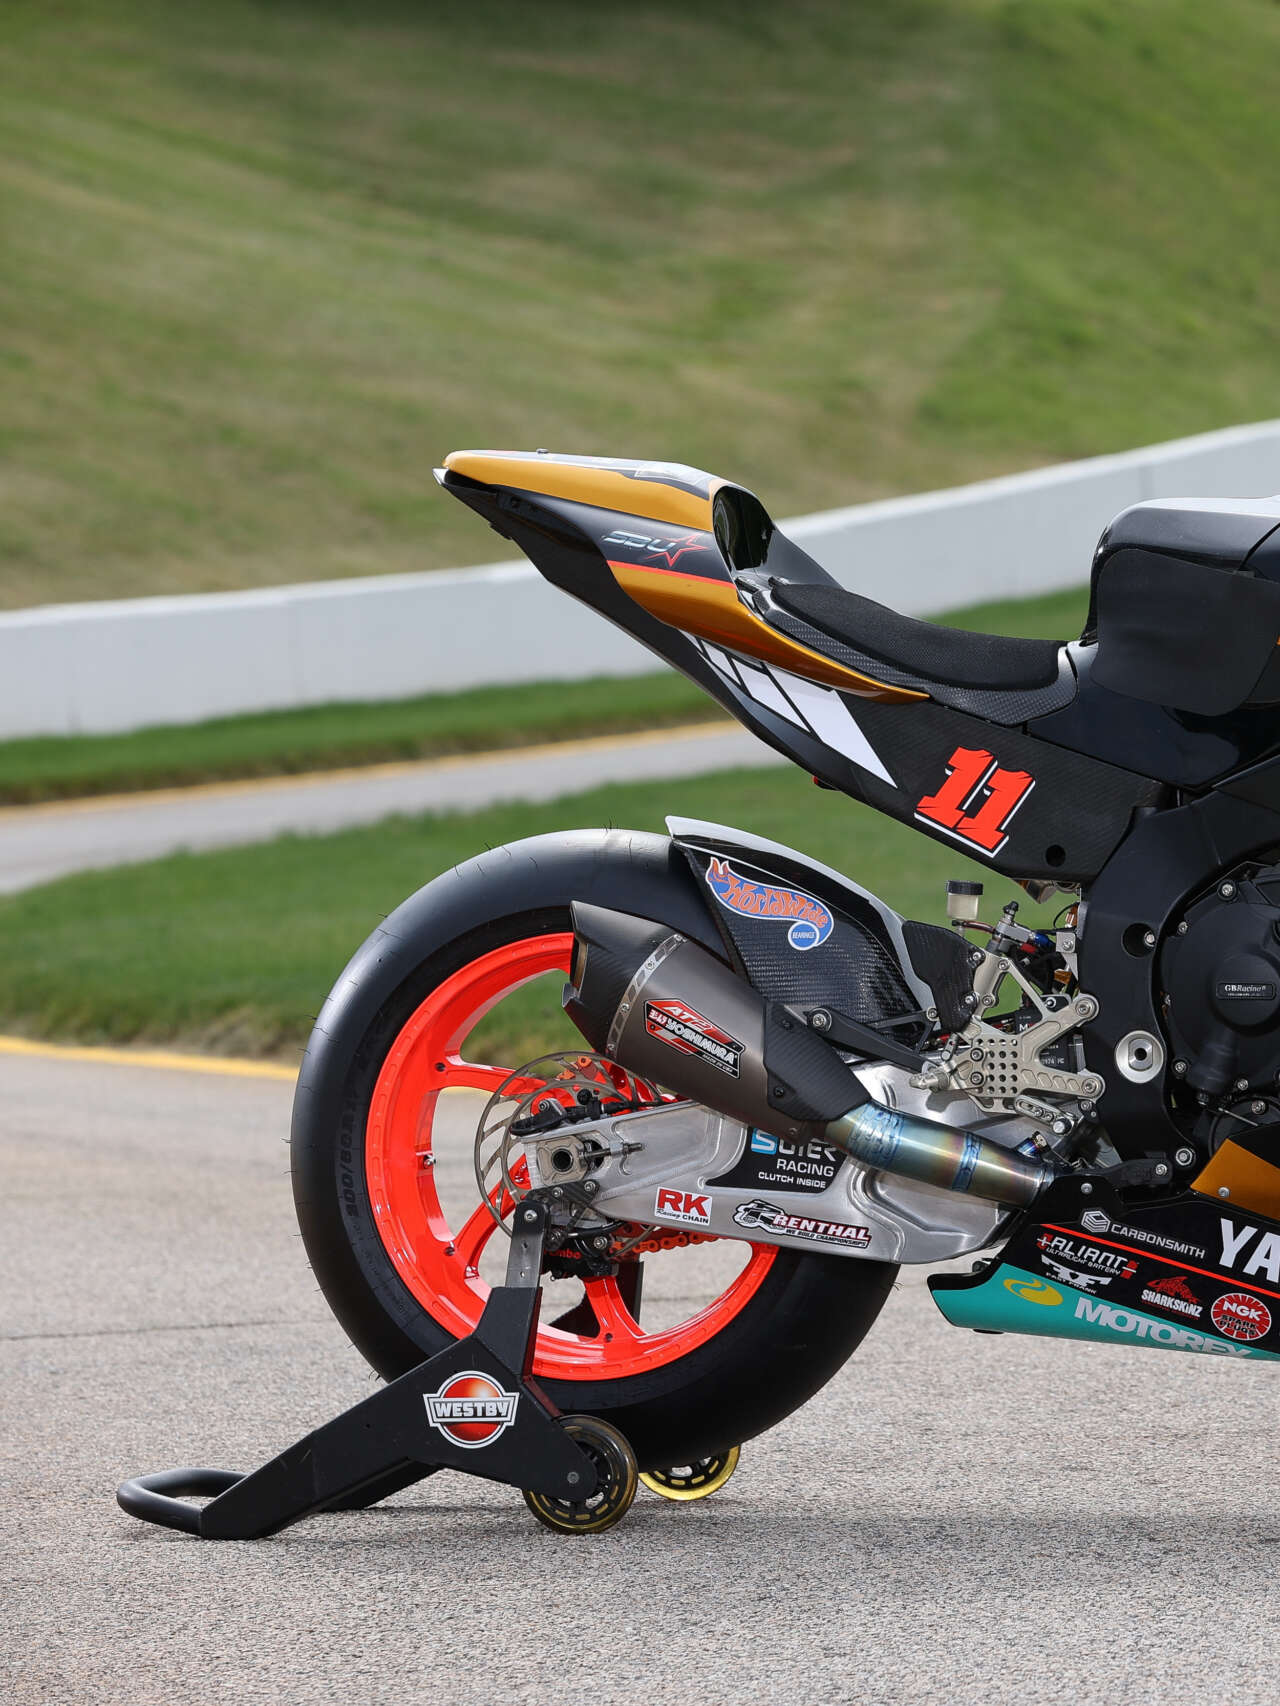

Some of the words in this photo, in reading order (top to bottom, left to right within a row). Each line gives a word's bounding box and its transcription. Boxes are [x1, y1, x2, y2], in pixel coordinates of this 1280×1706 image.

[914, 745, 1036, 858] 11
[665, 1017, 735, 1065] YOSHIMURA
[776, 1158, 835, 1177] RACING
[758, 1171, 794, 1184] CLUTCH
[796, 1177, 827, 1189] INSIDE
[657, 1188, 710, 1217] RK
[682, 1214, 709, 1224] CHAIN
[772, 1214, 871, 1241] RENTHAL
[1110, 1223, 1206, 1259] CARBONSMITH
[1220, 1314, 1259, 1329] SPARK
[1222, 1300, 1263, 1321] NGK
[1074, 1296, 1252, 1357] MOTOREX
[434, 1401, 510, 1418] WESTBY
